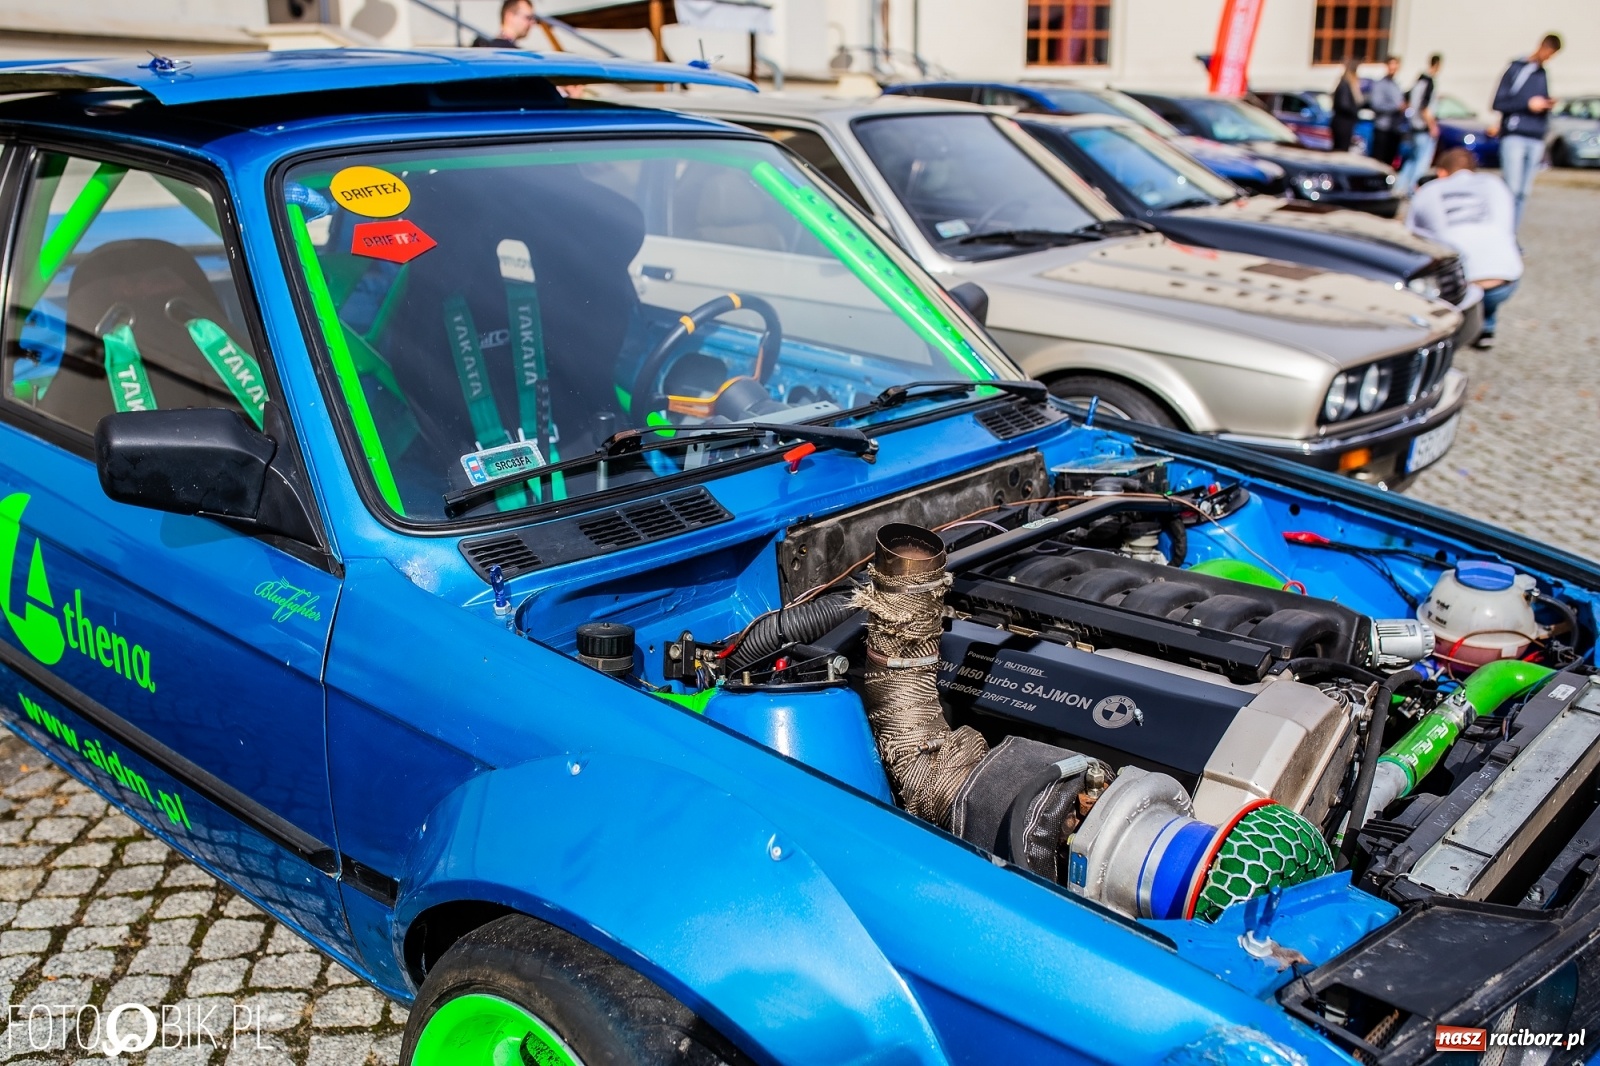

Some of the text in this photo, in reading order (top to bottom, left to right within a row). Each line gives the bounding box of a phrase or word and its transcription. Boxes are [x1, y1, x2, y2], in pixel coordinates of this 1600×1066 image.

[340, 182, 402, 202] DRIFTEX
[362, 233, 421, 248] DRIFTEX
[453, 314, 483, 397] TAKATA
[517, 304, 539, 386] TAKATA
[473, 473, 485, 481] PL
[494, 456, 532, 471] SRC83FA
[967, 650, 996, 663] Powered
[994, 657, 1004, 667] by
[936, 678, 1037, 713] RACIBÓRZ DRIFT TEAM
[956, 665, 984, 680] M50
[984, 673, 1019, 690] turbo
[1020, 681, 1093, 710] SAJMON
[18, 692, 193, 830] www.aidm.pl
